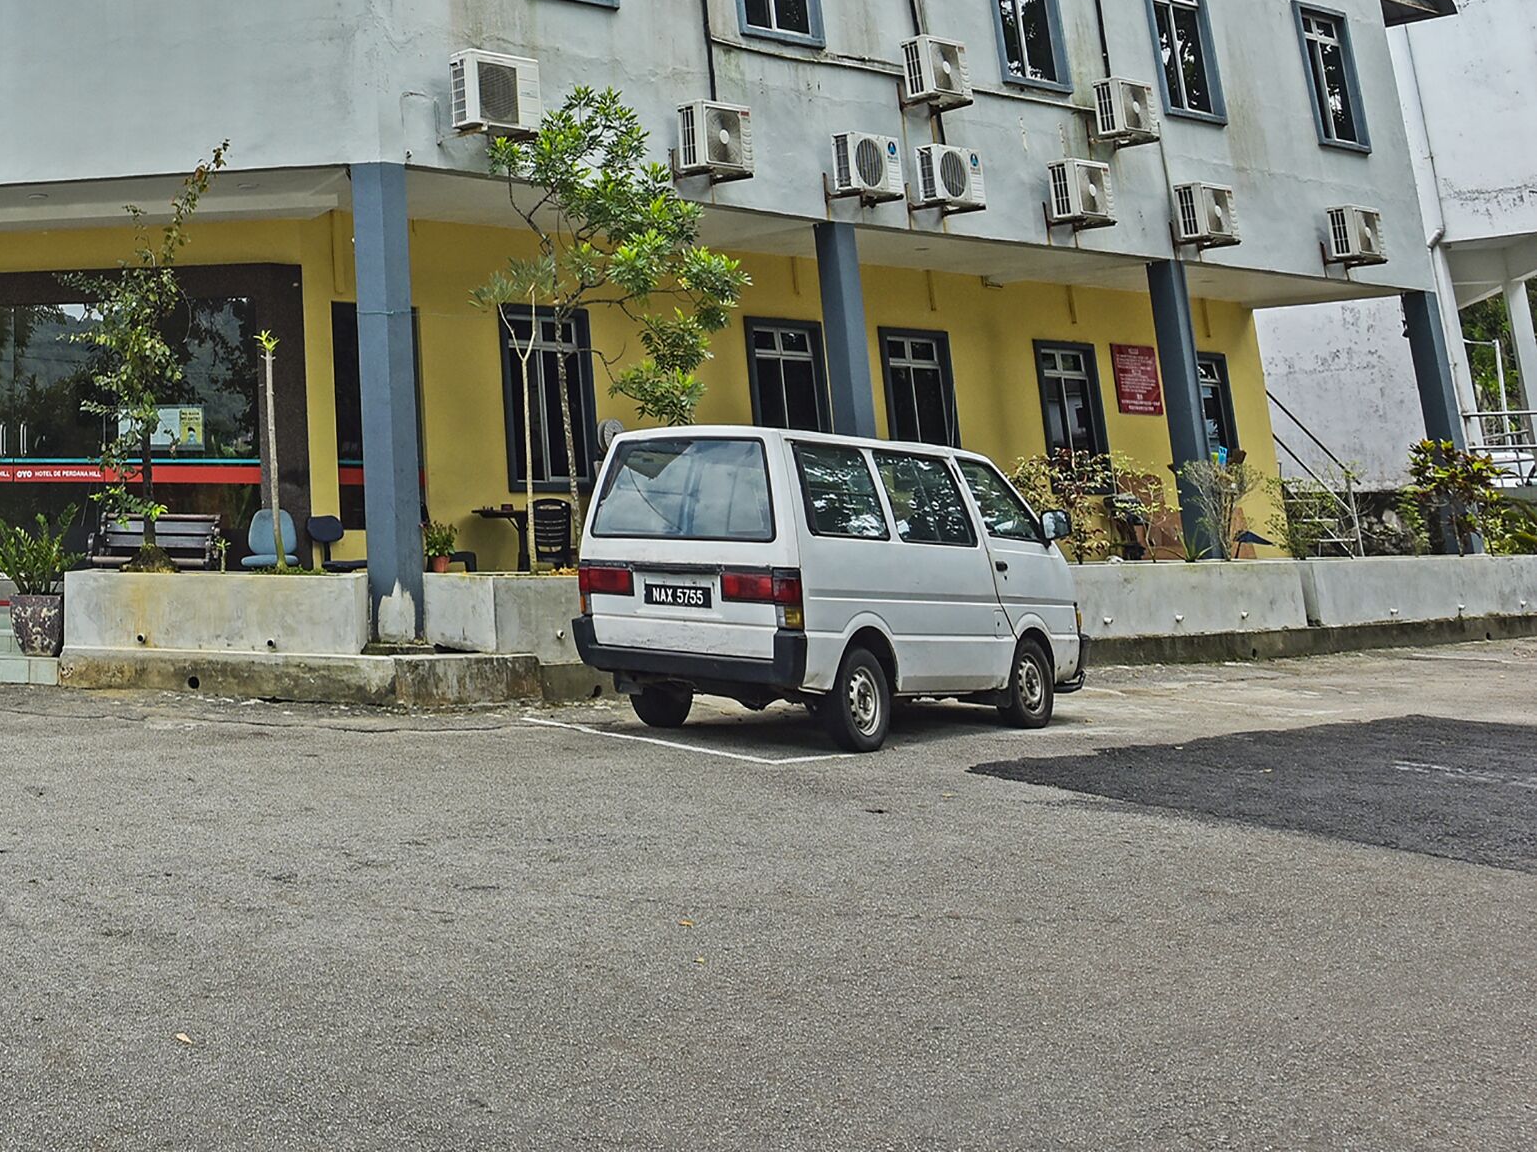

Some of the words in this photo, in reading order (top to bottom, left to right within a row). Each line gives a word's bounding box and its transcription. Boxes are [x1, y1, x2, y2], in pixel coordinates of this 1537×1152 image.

[16, 470, 33, 478] OYO
[34, 470, 53, 478] HOTEL
[53, 470, 61, 478] DE
[62, 470, 89, 478] PERDANA
[89, 470, 101, 478] HILL
[652, 587, 673, 603] NAX
[676, 588, 704, 605] 5755
